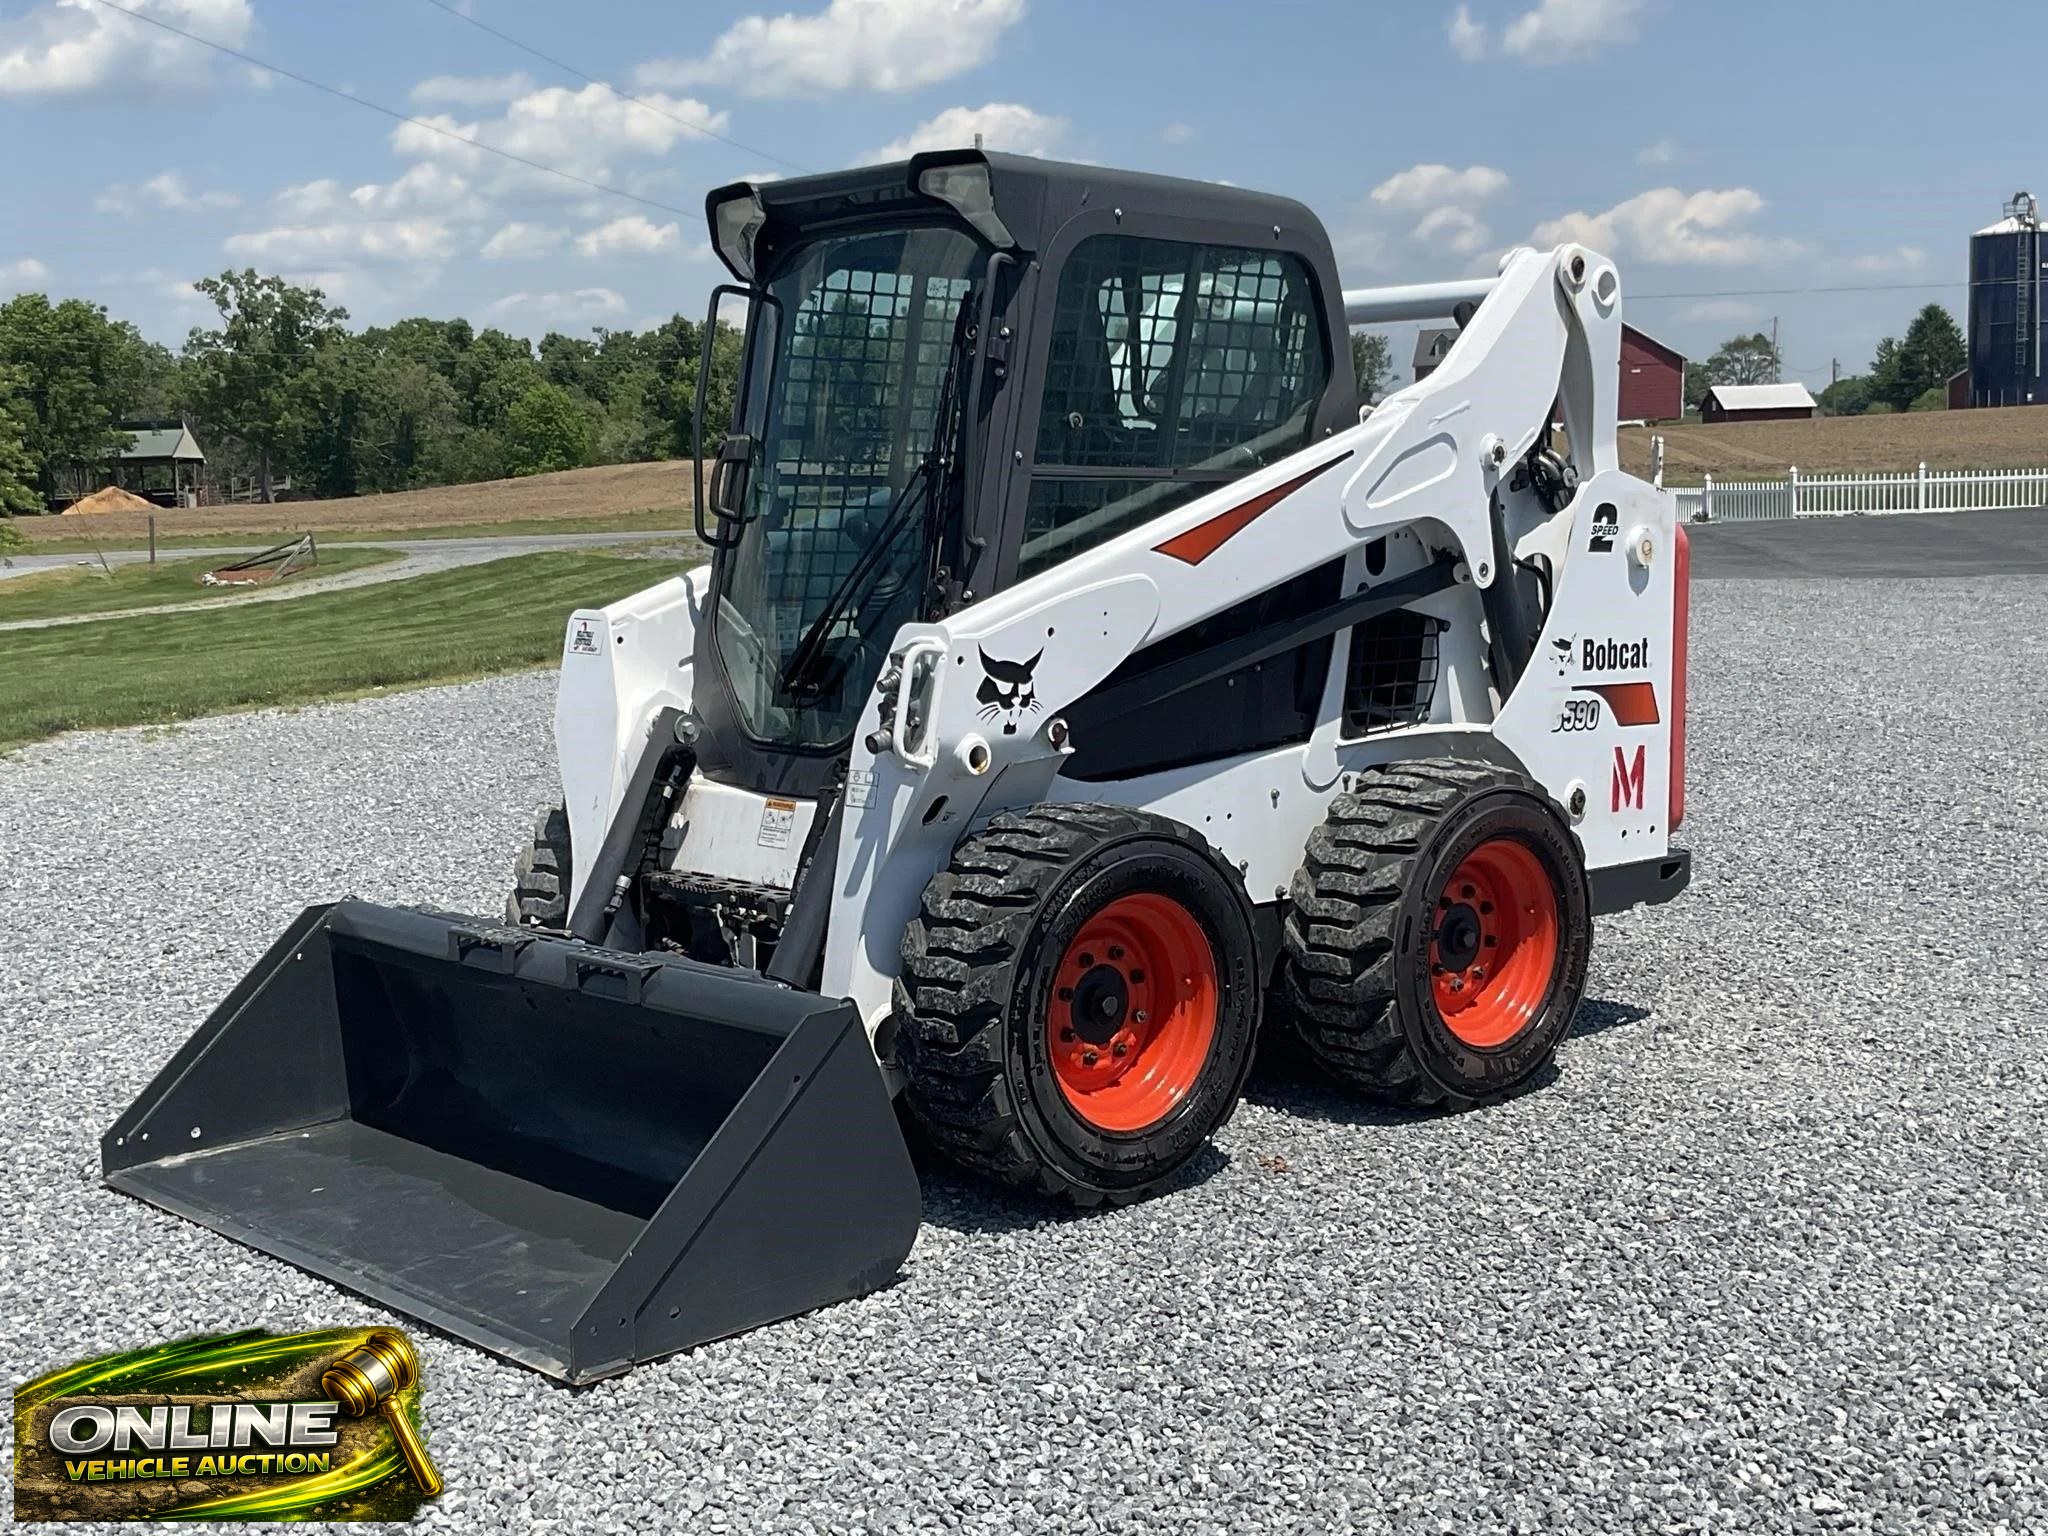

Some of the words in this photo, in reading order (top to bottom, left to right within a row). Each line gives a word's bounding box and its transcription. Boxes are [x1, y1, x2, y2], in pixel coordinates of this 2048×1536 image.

[1588, 502, 1618, 552] 2
[1591, 525, 1619, 536] SPEED
[1582, 637, 1648, 671] Bobcat
[1611, 745, 1646, 813] M
